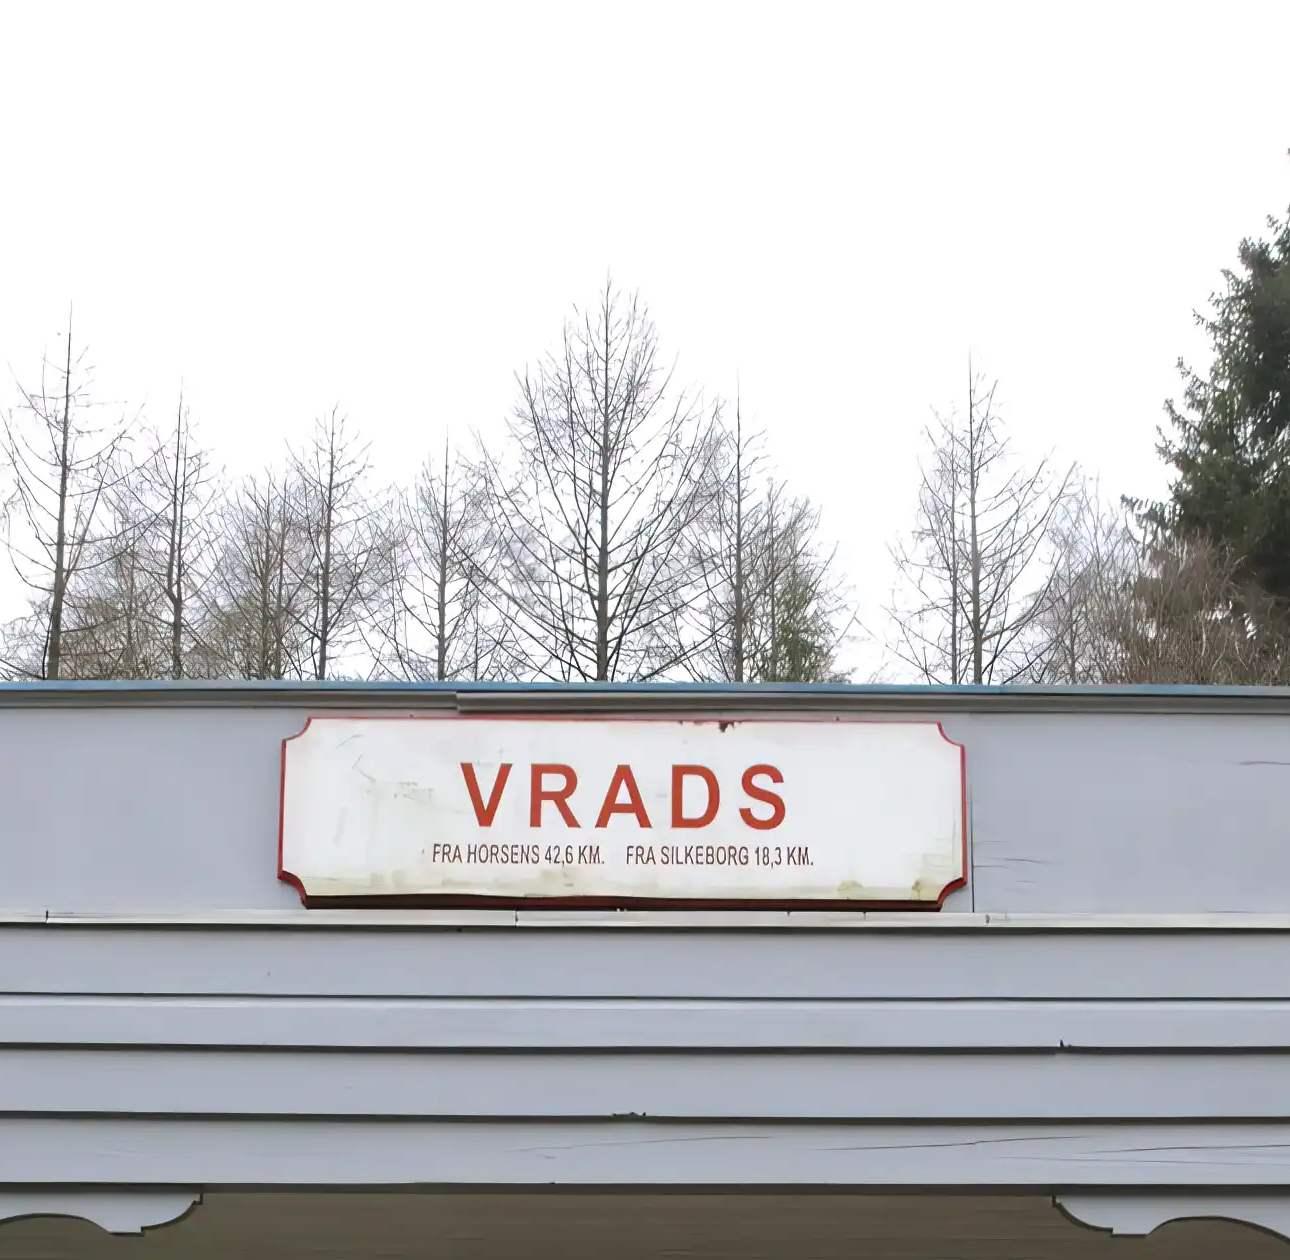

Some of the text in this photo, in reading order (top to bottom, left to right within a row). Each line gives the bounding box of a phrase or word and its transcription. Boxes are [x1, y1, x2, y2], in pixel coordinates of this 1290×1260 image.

[460, 762, 786, 831] VRADS
[432, 843, 605, 868] FRA HORSENS 42,6 KM.
[626, 845, 815, 869] FRA SILKEBORG 18,3 KM.
